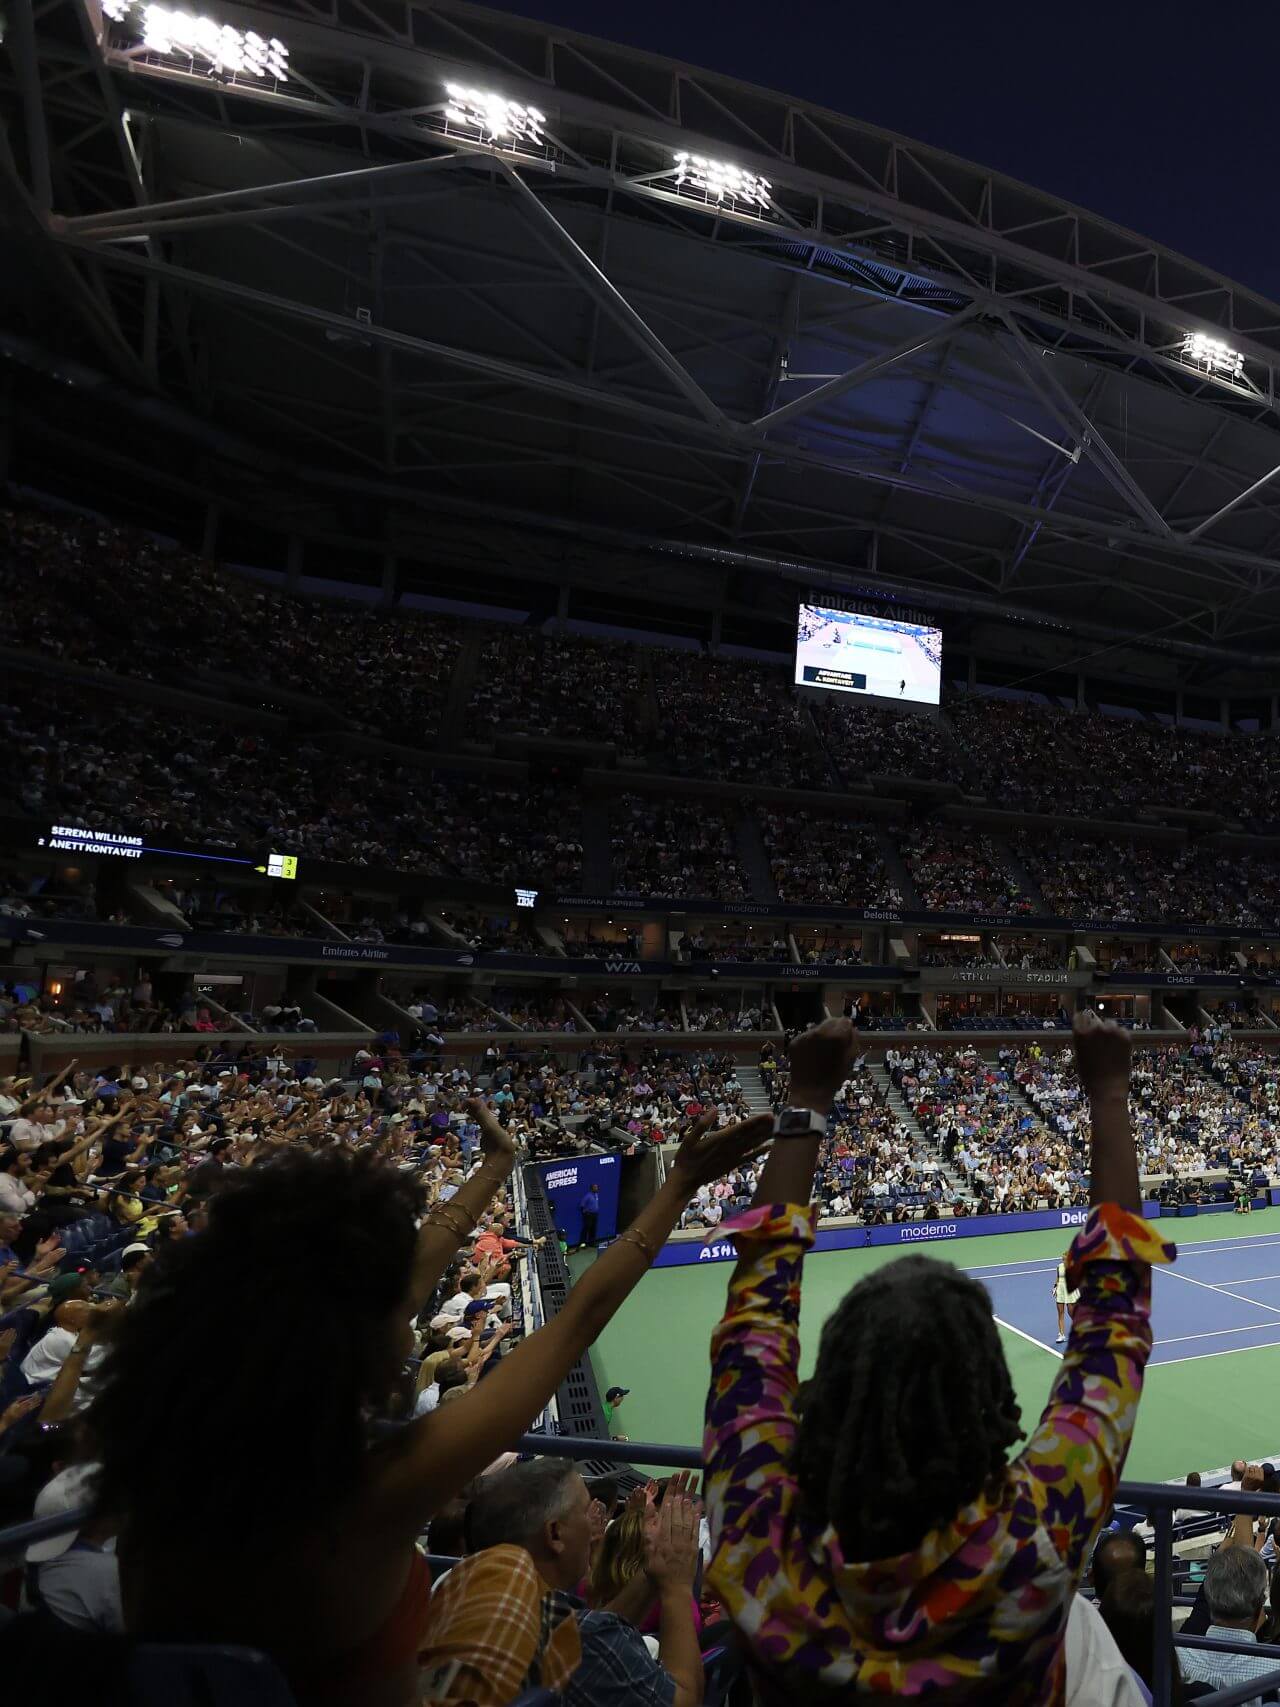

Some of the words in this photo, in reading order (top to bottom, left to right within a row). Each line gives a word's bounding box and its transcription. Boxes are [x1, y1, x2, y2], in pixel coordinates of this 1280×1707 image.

[809, 590, 878, 616] Emirates
[883, 604, 936, 626] Airline
[51, 825, 94, 840] SERENA
[94, 831, 142, 846] WILLIAMS
[38, 838, 45, 846] 2
[49, 839, 85, 852] ANETT
[85, 844, 142, 859] KONTAVEIT
[516, 896, 535, 908] IBM
[557, 897, 602, 905] AMERICAN
[605, 899, 646, 907] EXPRESS
[724, 903, 769, 914] moderna
[863, 910, 901, 921] Deloitte.
[322, 946, 359, 957] Emirates
[362, 949, 389, 959] Airline
[605, 962, 641, 973] WTA
[1026, 973, 1068, 983] STADIUM
[1167, 976, 1195, 984] CHASE
[545, 1167, 578, 1182] AMERICAN
[548, 1176, 578, 1189] EXPRESS
[901, 1224, 957, 1238] moderna
